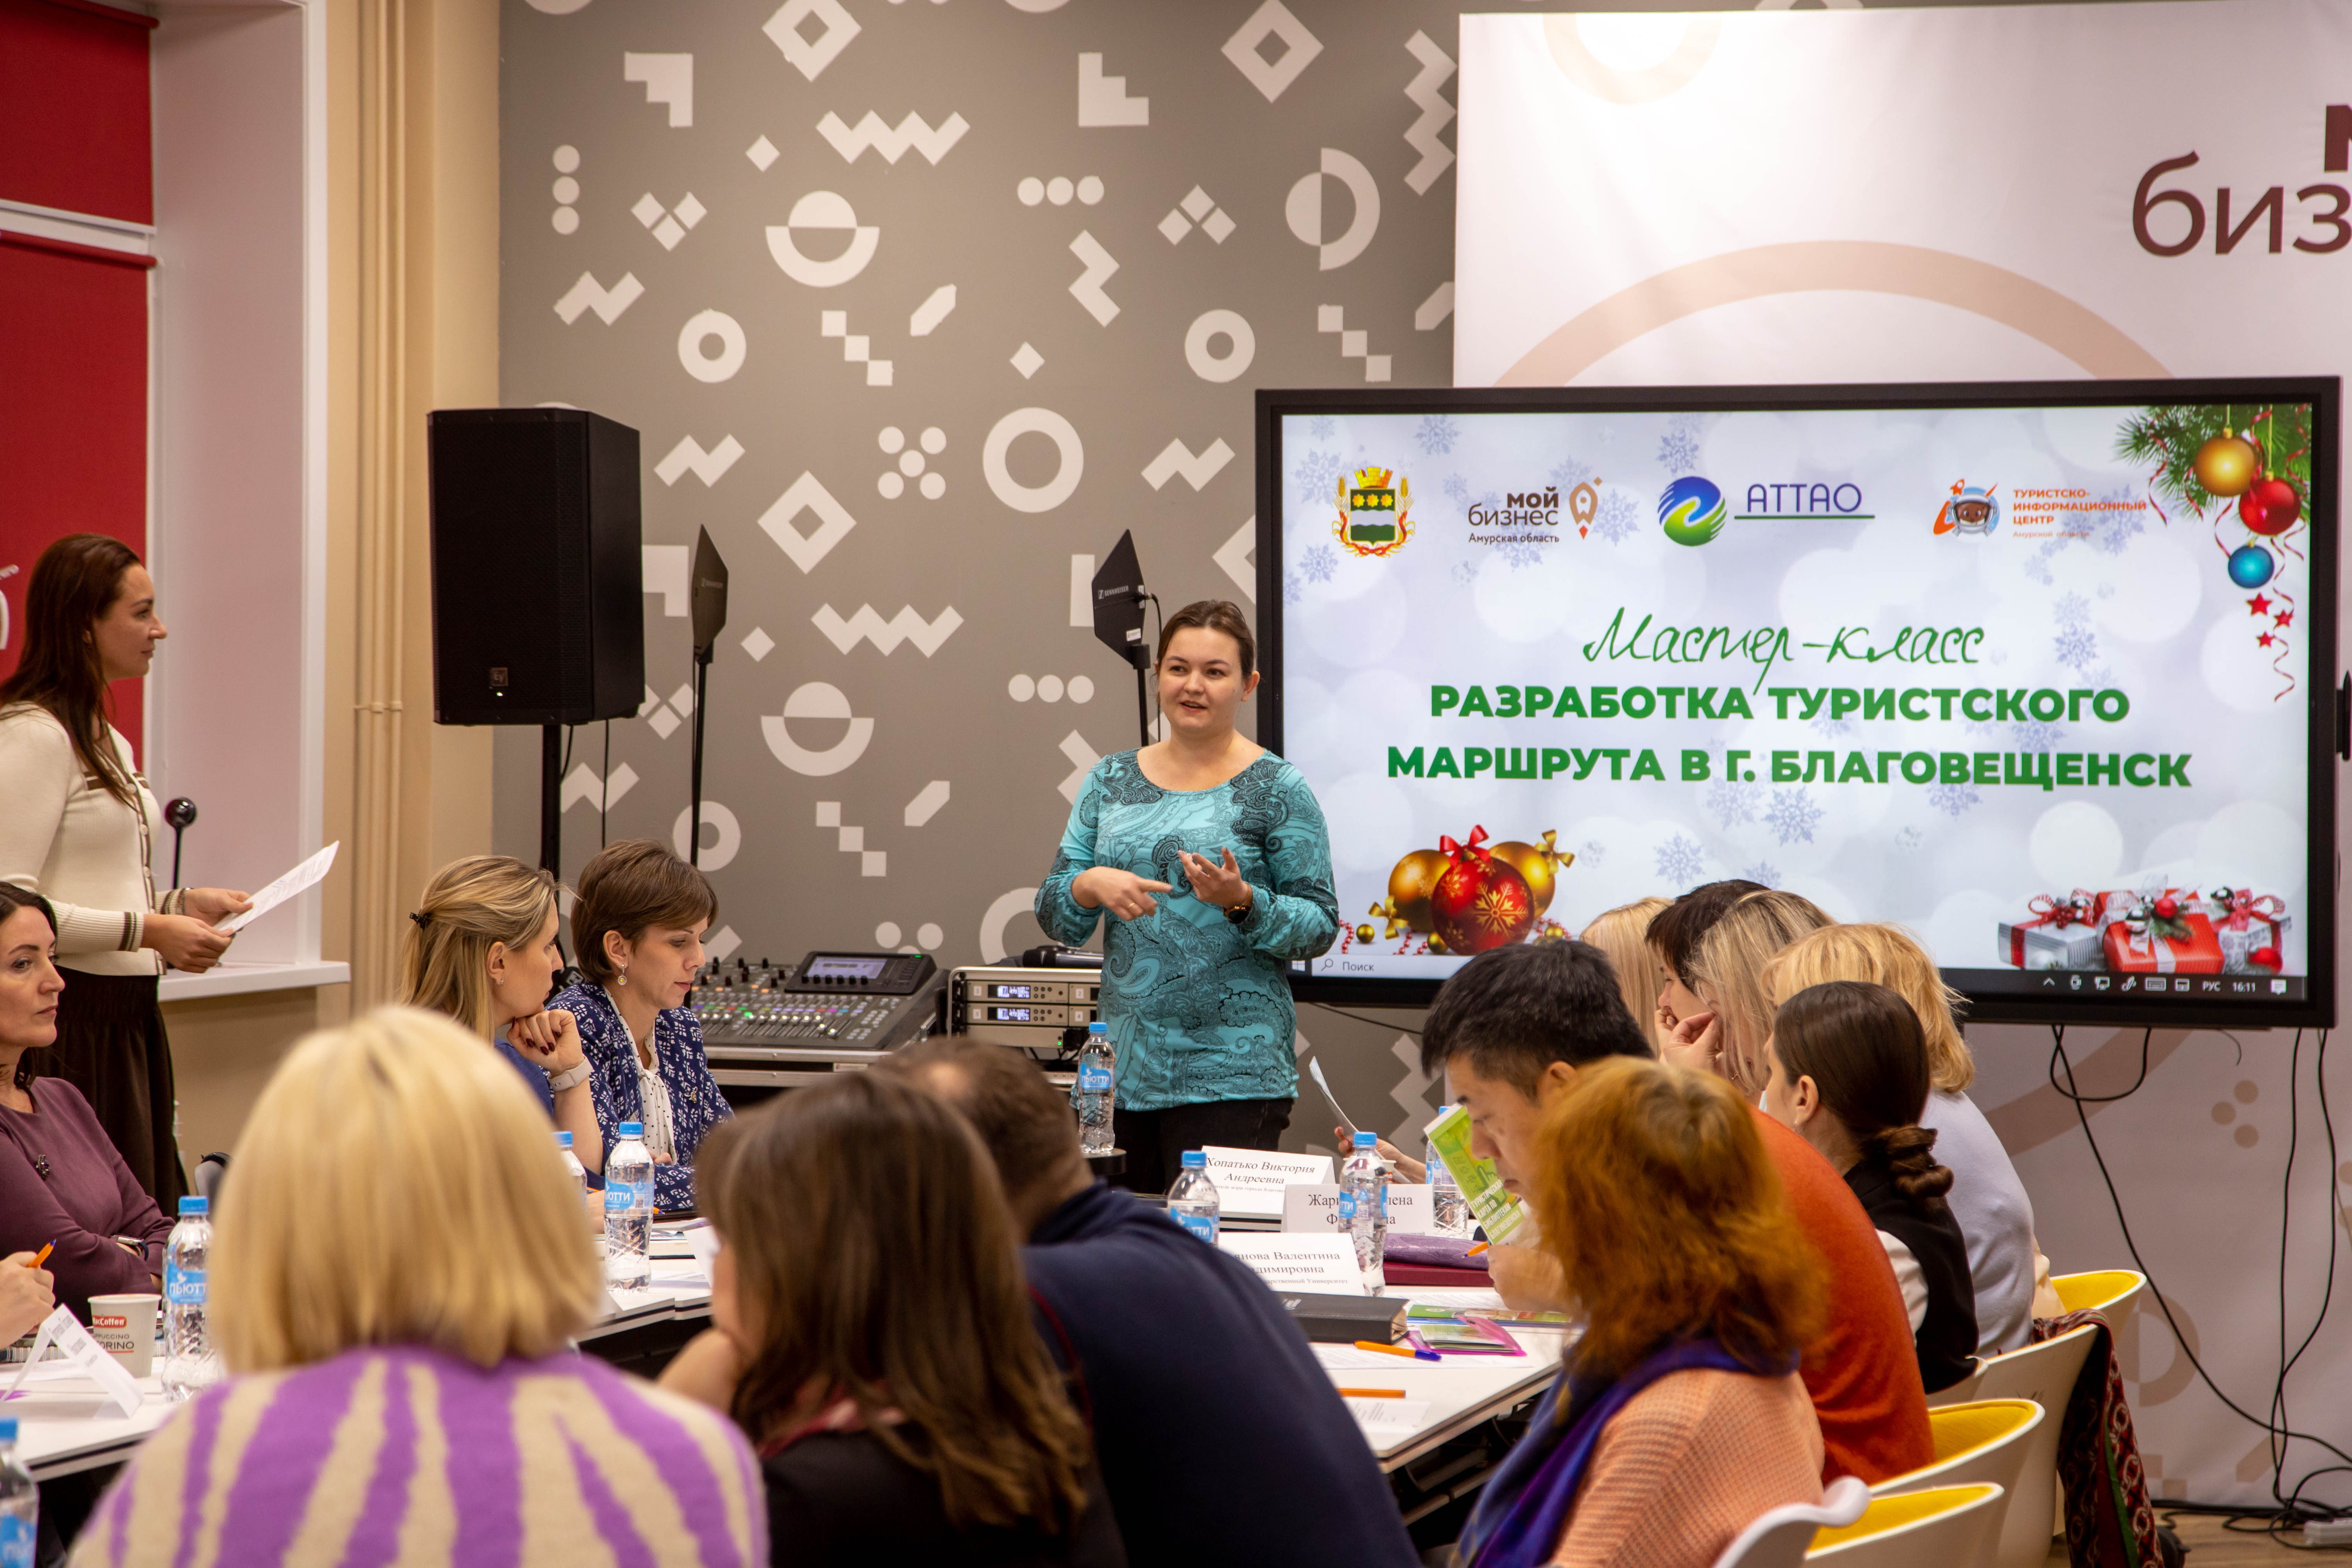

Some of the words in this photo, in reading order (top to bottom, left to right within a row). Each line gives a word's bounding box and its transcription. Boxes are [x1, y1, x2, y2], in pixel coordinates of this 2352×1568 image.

[2132, 150, 2352, 257] биз
[2013, 489, 2091, 498] ТУРИСТСКО-
[2013, 499, 2147, 512] ИНФОРМАЦИОННЫЙ
[1468, 502, 1559, 526] бизнес
[2013, 515, 2055, 526] ЦЕНТР
[1468, 533, 1518, 545] Амурская
[1520, 533, 1560, 543] область
[1583, 607, 1984, 695] Мастер-класс
[1431, 685, 1753, 720] РАЗРАБОТКА
[1767, 687, 2129, 722] ТУРИСТСКОГО
[1388, 746, 1665, 781] МАРШРУТА
[1681, 749, 1710, 781] В
[1726, 750, 1755, 782] Г.
[1771, 750, 2190, 792] БЛАГОВЕЩЕНСК
[1343, 961, 1375, 971] Поиск
[2202, 981, 2221, 992] РУС
[2233, 981, 2256, 992] 16:11
[1206, 1157, 1258, 1170] Хопатько
[1262, 1162, 1315, 1174] Виктория
[1224, 1173, 1285, 1184] Андреевна
[1471, 1179, 1504, 1209] ТУРИСТИЧЕСКАЯ
[1477, 1203, 1490, 1219] КАРТА
[1489, 1199, 1497, 1210] ПО
[1483, 1202, 1512, 1230] БИБЛИОТЕКАМ
[1273, 1252, 1341, 1260] Валентина
[1253, 1267, 1325, 1275] димировна
